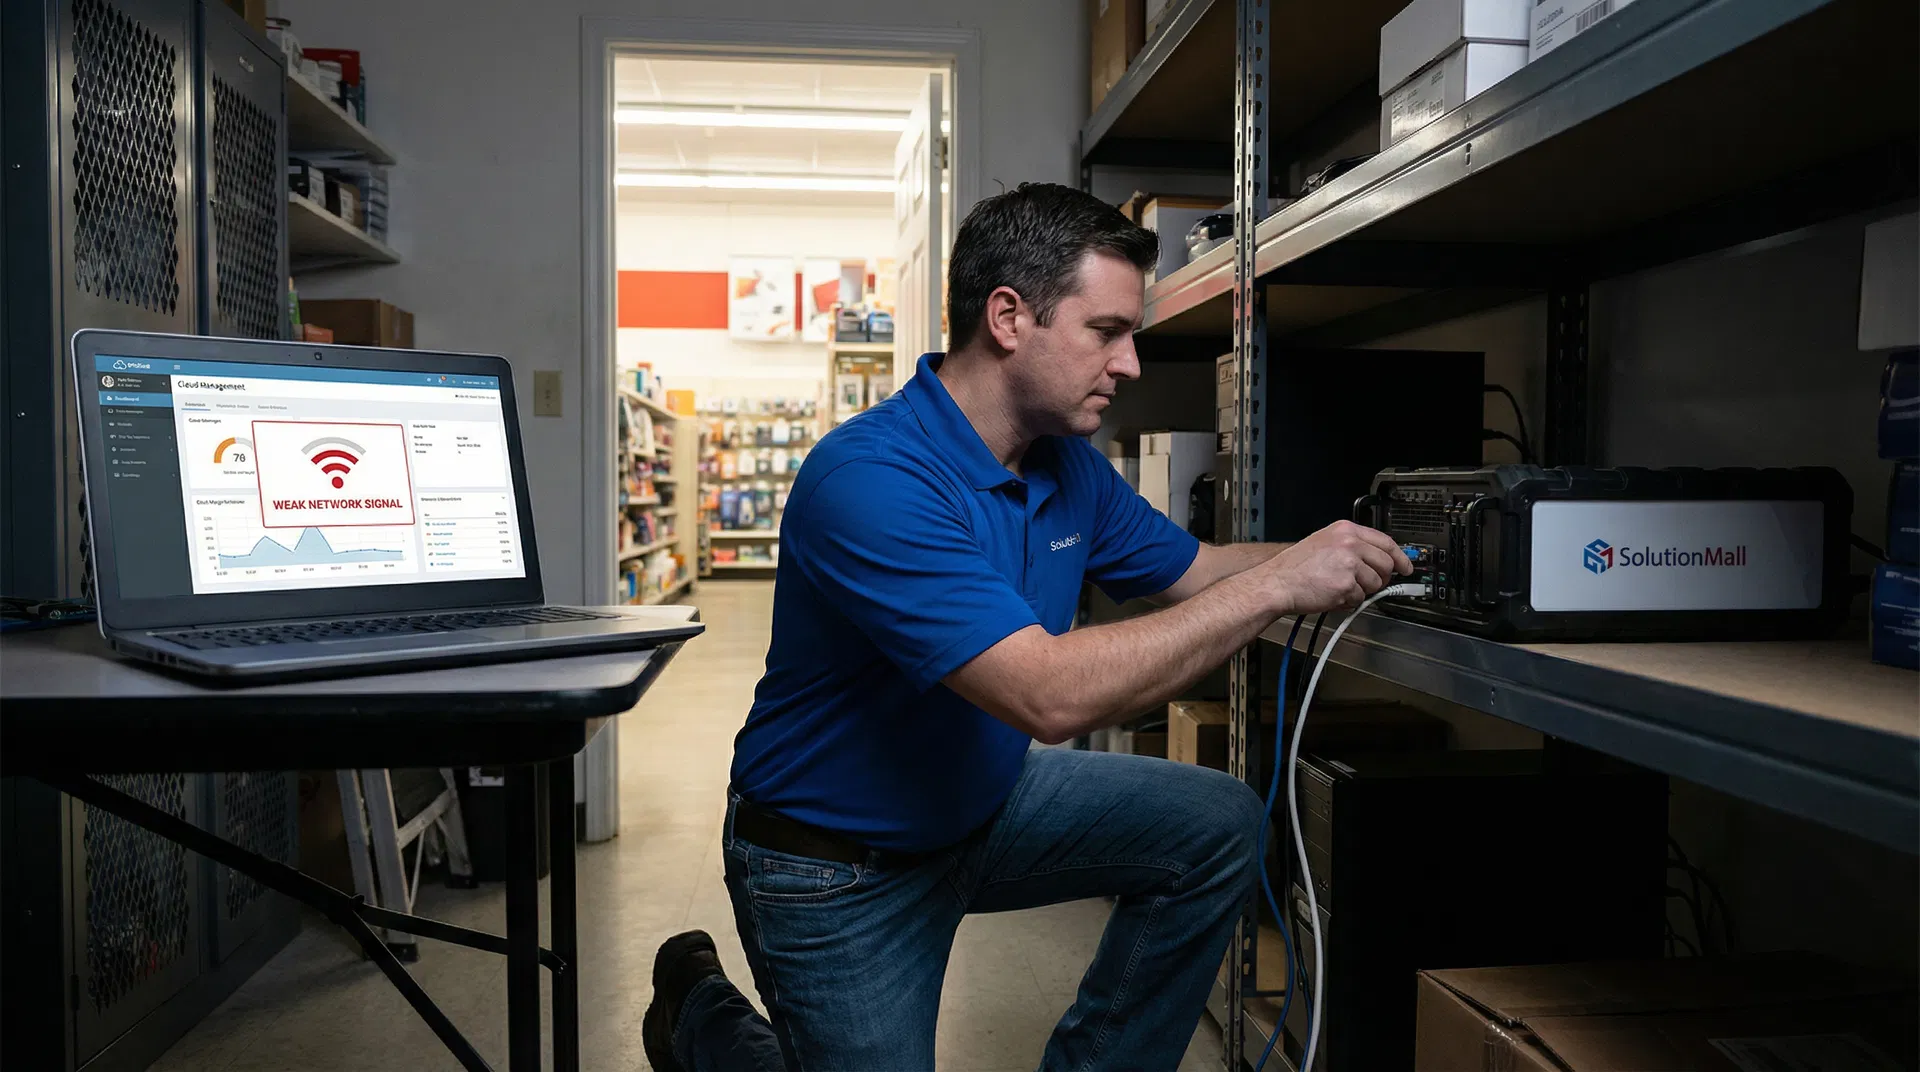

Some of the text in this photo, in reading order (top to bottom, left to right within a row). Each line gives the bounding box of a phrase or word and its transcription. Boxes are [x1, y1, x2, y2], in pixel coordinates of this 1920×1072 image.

[178, 380, 246, 391] Cloud Management
[273, 498, 403, 510] WEAK NETWORK SIGNAL
[1619, 545, 1746, 567] SolutionMall
